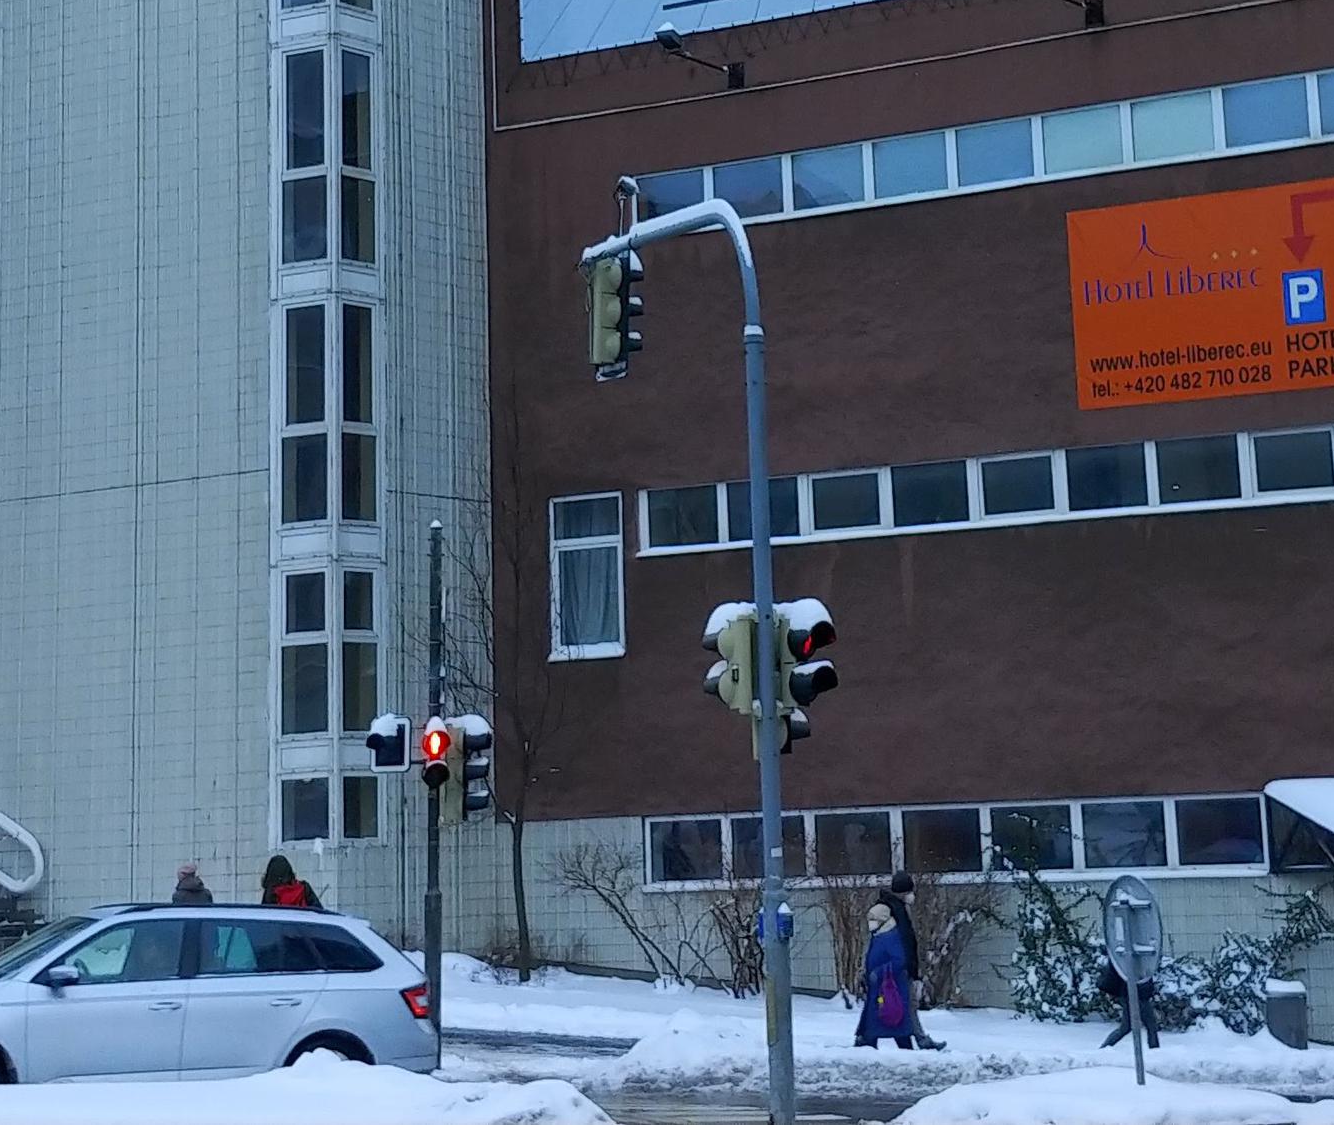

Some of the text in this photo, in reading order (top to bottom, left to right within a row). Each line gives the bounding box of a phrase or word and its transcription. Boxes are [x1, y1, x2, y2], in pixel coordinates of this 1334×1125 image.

[1091, 338, 1272, 373] www.hotel-liberec.eu
[1092, 364, 1271, 398] tel.: +420 482 710 028
